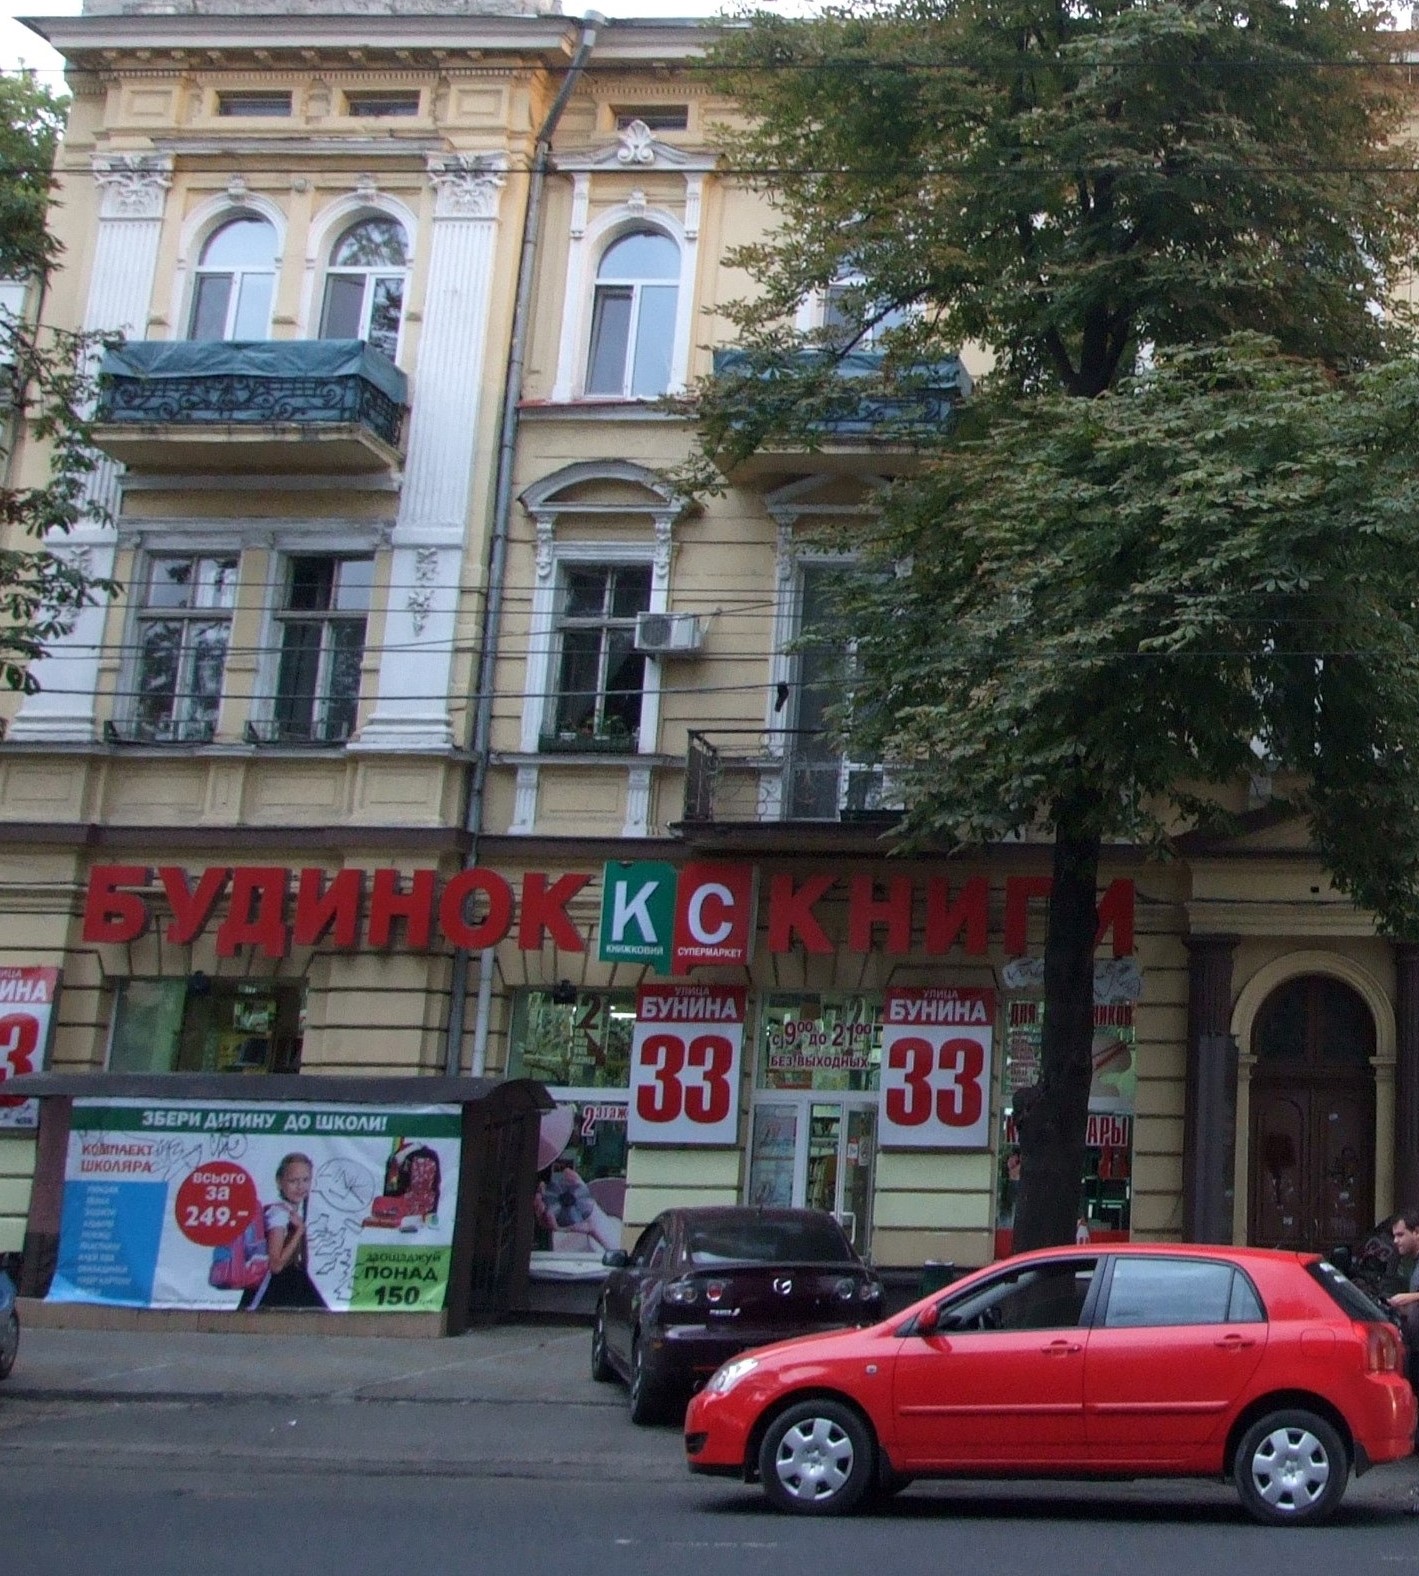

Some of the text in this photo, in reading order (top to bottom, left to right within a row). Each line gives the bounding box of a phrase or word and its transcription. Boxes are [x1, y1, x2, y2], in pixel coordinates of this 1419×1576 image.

[83, 865, 1134, 957] БУДИНОК КНИГИ
[612, 880, 735, 945] К С
[677, 947, 743, 958] СУПЕРМАРКЕТ
[674, 986, 711, 997] УЛИЦА
[923, 989, 960, 999] УЛИЦА
[641, 996, 738, 1019] БУНИНА
[889, 999, 988, 1022] БУНИНА
[797, 1056, 869, 1070] ВЫХОДНЫХ
[636, 1034, 734, 1124] 33
[886, 1037, 985, 1127] 33
[142, 1111, 389, 1132] ЗБЕРИ ДИТИНУ ДО ШКОЛИ!
[80, 1160, 152, 1174] ШКОЛЯРА
[364, 1265, 438, 1282] ПОНАД
[374, 1285, 420, 1306] 150
